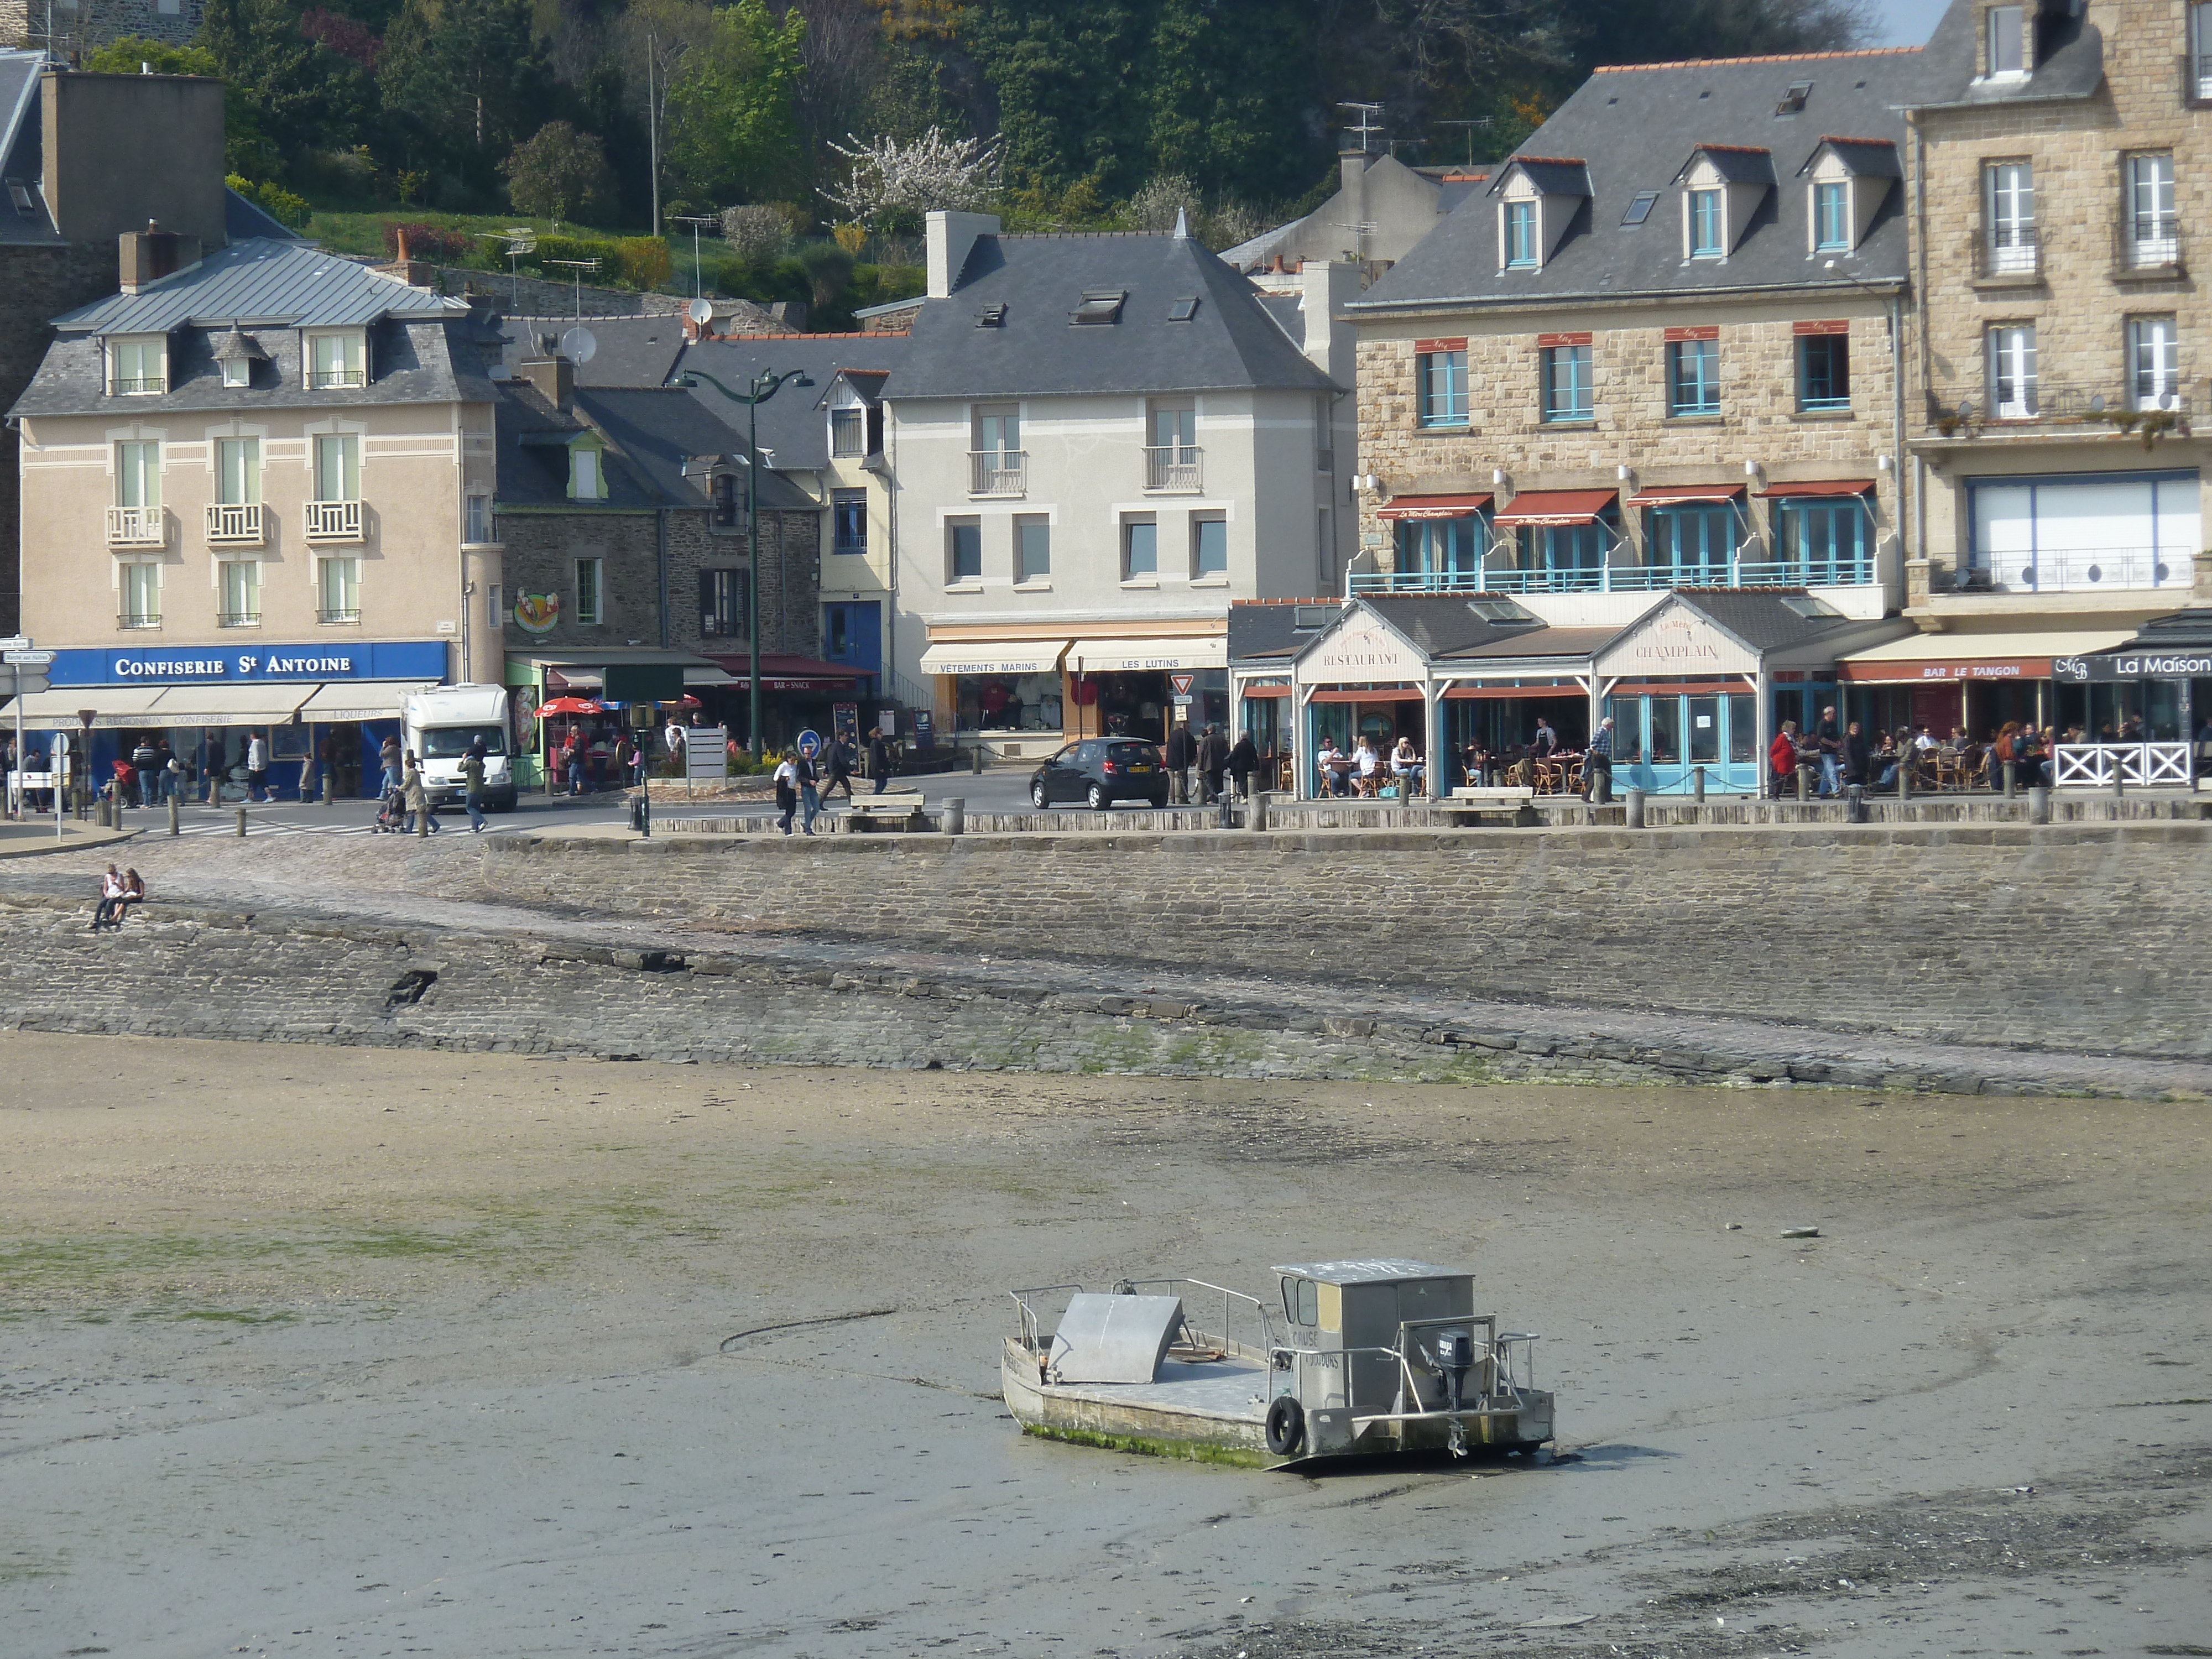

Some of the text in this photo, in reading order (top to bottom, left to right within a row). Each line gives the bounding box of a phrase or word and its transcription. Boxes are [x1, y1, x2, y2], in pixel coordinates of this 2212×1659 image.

[1423, 509, 1453, 518] Champlain
[1636, 645, 1715, 658] CHAMPLAIN
[239, 656, 257, 673] St
[266, 655, 351, 672] ANTOINE
[1122, 659, 1179, 669] LES LUTINS
[1324, 654, 1399, 666] RESTAURANT
[2117, 657, 2139, 674] La
[2144, 656, 2212, 673] Maison
[940, 664, 994, 672] VÊTEMENTS
[1924, 666, 2020, 677] BAR LE TANGON
[174, 715, 233, 724] CONFISERIE
[333, 709, 383, 719] LIQUEURS
[1293, 1331, 1318, 1347] CAUSE
